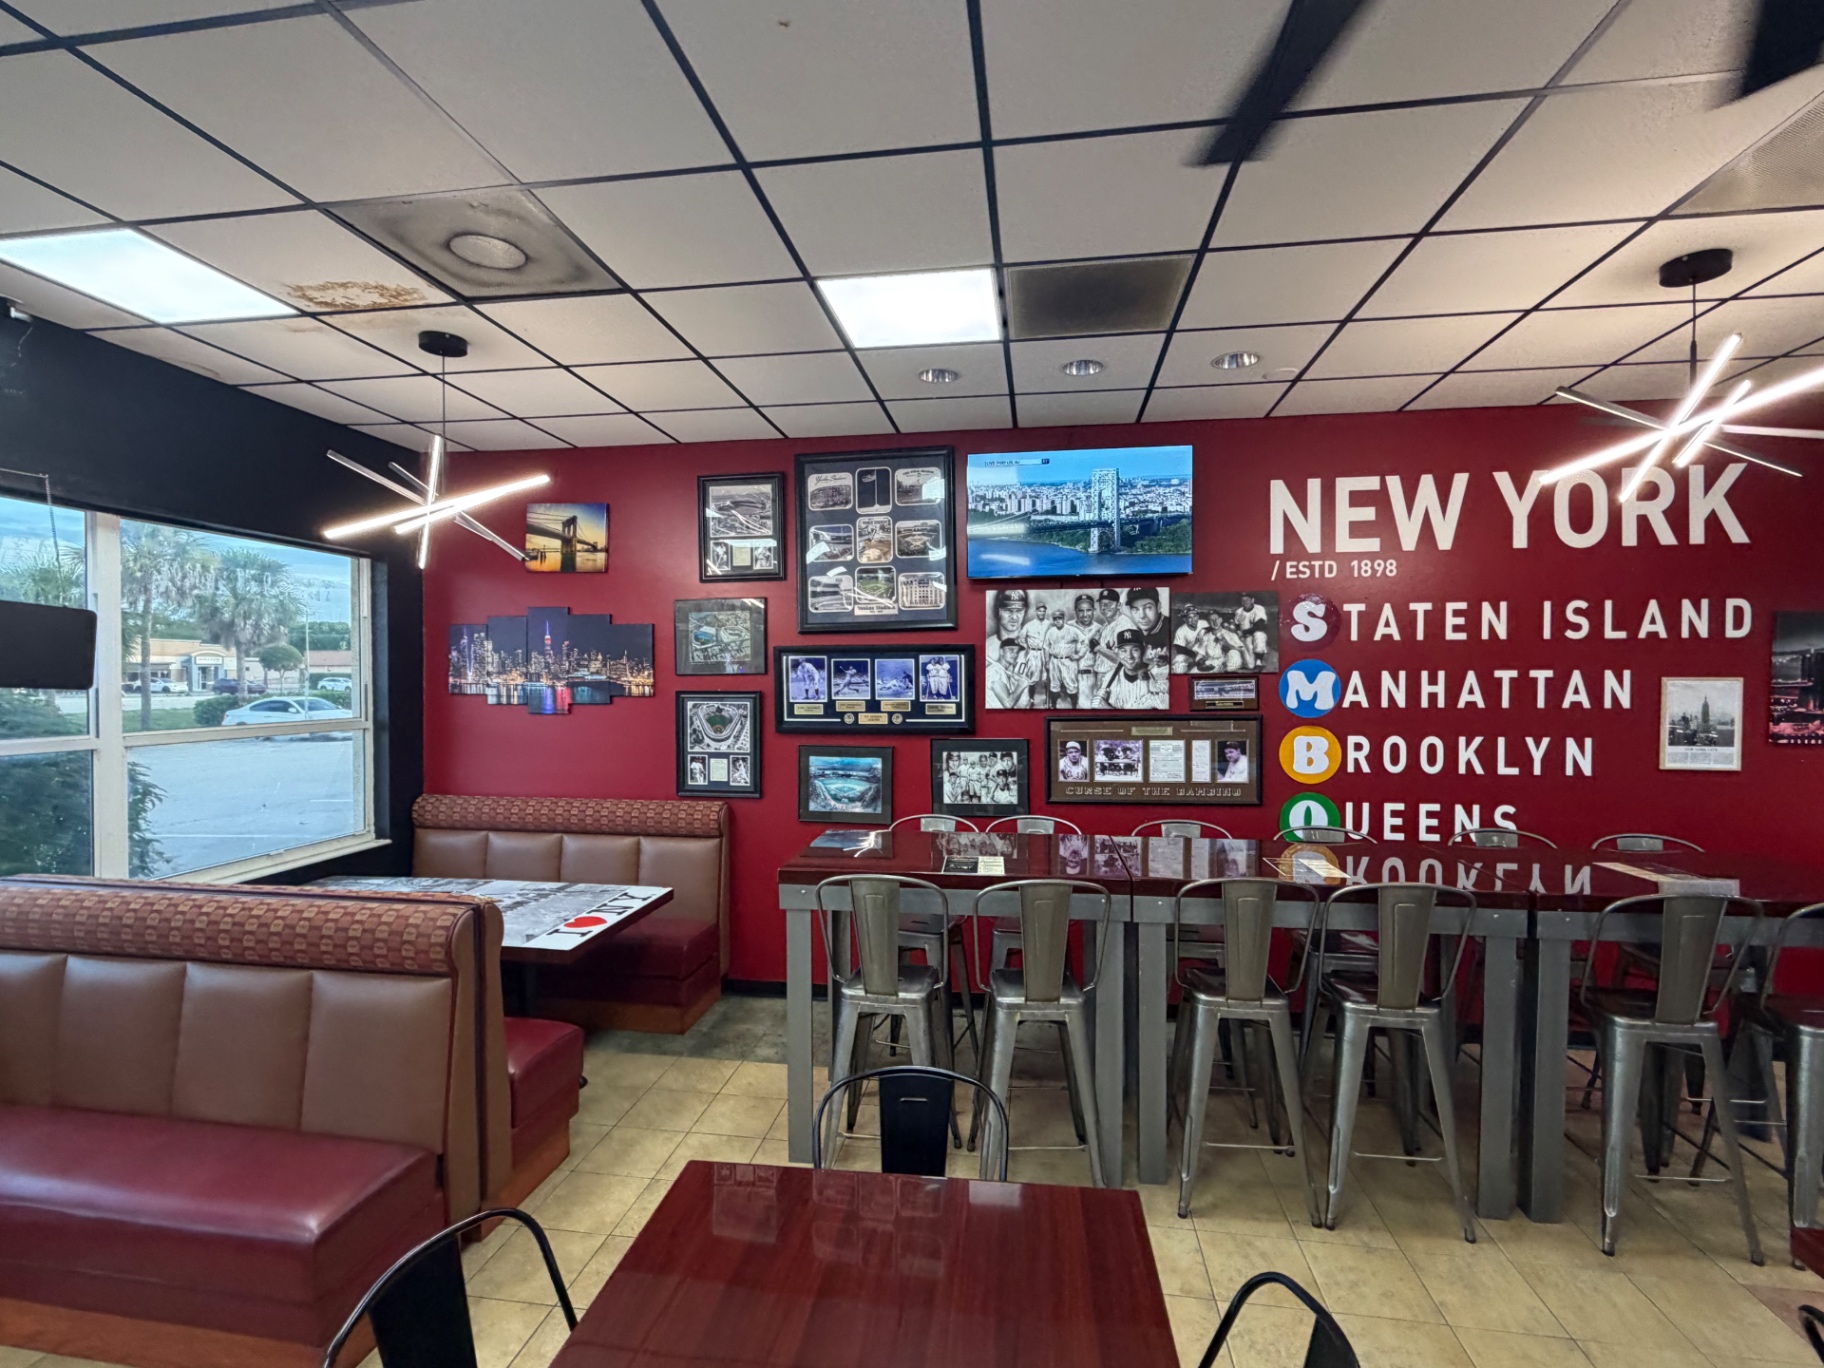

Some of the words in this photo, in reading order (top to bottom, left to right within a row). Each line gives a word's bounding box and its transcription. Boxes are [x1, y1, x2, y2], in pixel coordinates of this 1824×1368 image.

[1270, 473, 1470, 554] NEW
[1492, 462, 1751, 549] YORK
[1350, 559, 1398, 578] 1898
[1291, 600, 1507, 642] STATEN
[1543, 599, 1752, 640] ISLAND
[1286, 670, 1631, 710] MANHATTAN
[1293, 736, 1592, 776] BROOKLYN
[1065, 786, 1112, 795] CURSE
[1118, 787, 1136, 795] OF
[1142, 787, 1171, 796] THE
[1176, 787, 1242, 797] BAMBINO
